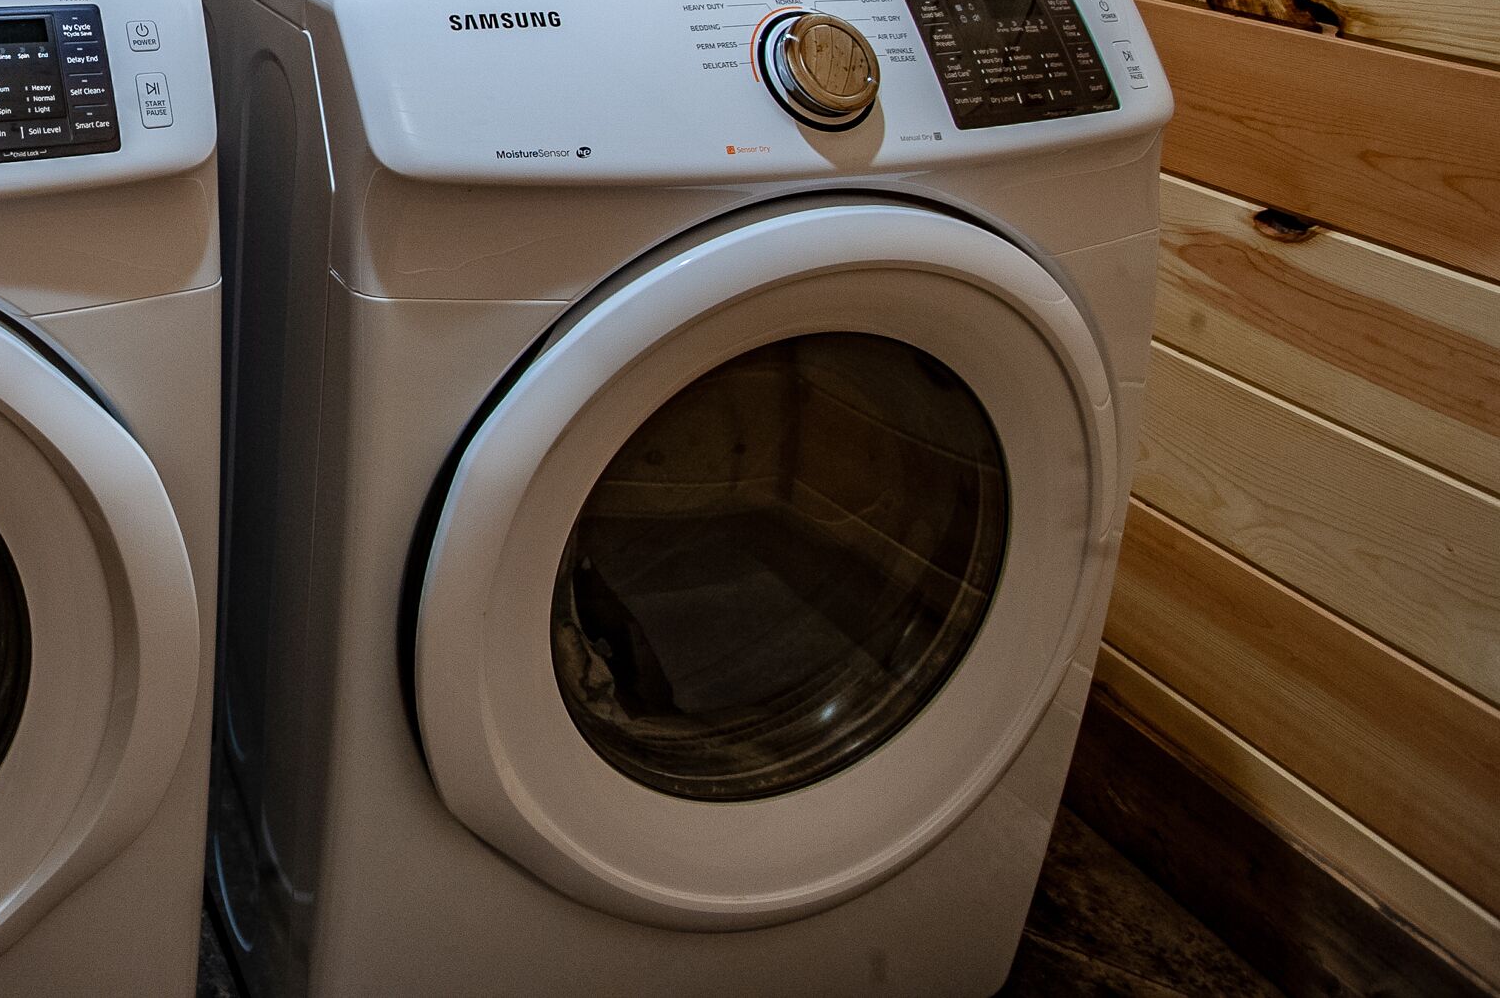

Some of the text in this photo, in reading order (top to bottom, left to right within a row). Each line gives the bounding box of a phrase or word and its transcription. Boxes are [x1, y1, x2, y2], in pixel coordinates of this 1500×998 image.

[683, 2, 725, 12] HEAVY DUTY
[448, 11, 562, 31] SAMSUNG
[871, 14, 901, 23] TIME DRY
[62, 23, 91, 32] My Cycle
[690, 23, 721, 32] BEDDING
[877, 32, 909, 41] AIR FLUFF
[132, 38, 157, 46] POWER
[696, 41, 738, 51] PERM PRESS
[885, 47, 914, 55] WRINKLE
[66, 55, 99, 64] Delay End
[889, 55, 917, 63] RELEASE
[702, 60, 739, 70] DELICATES
[31, 84, 52, 92] Heavy
[70, 87, 106, 96] Self Clean+
[34, 106, 51, 114] Light
[146, 108, 168, 116] PAUSE
[75, 120, 110, 130] Smart Care
[28, 126, 62, 136] Soil Level
[495, 147, 570, 159] MoistureSensor
